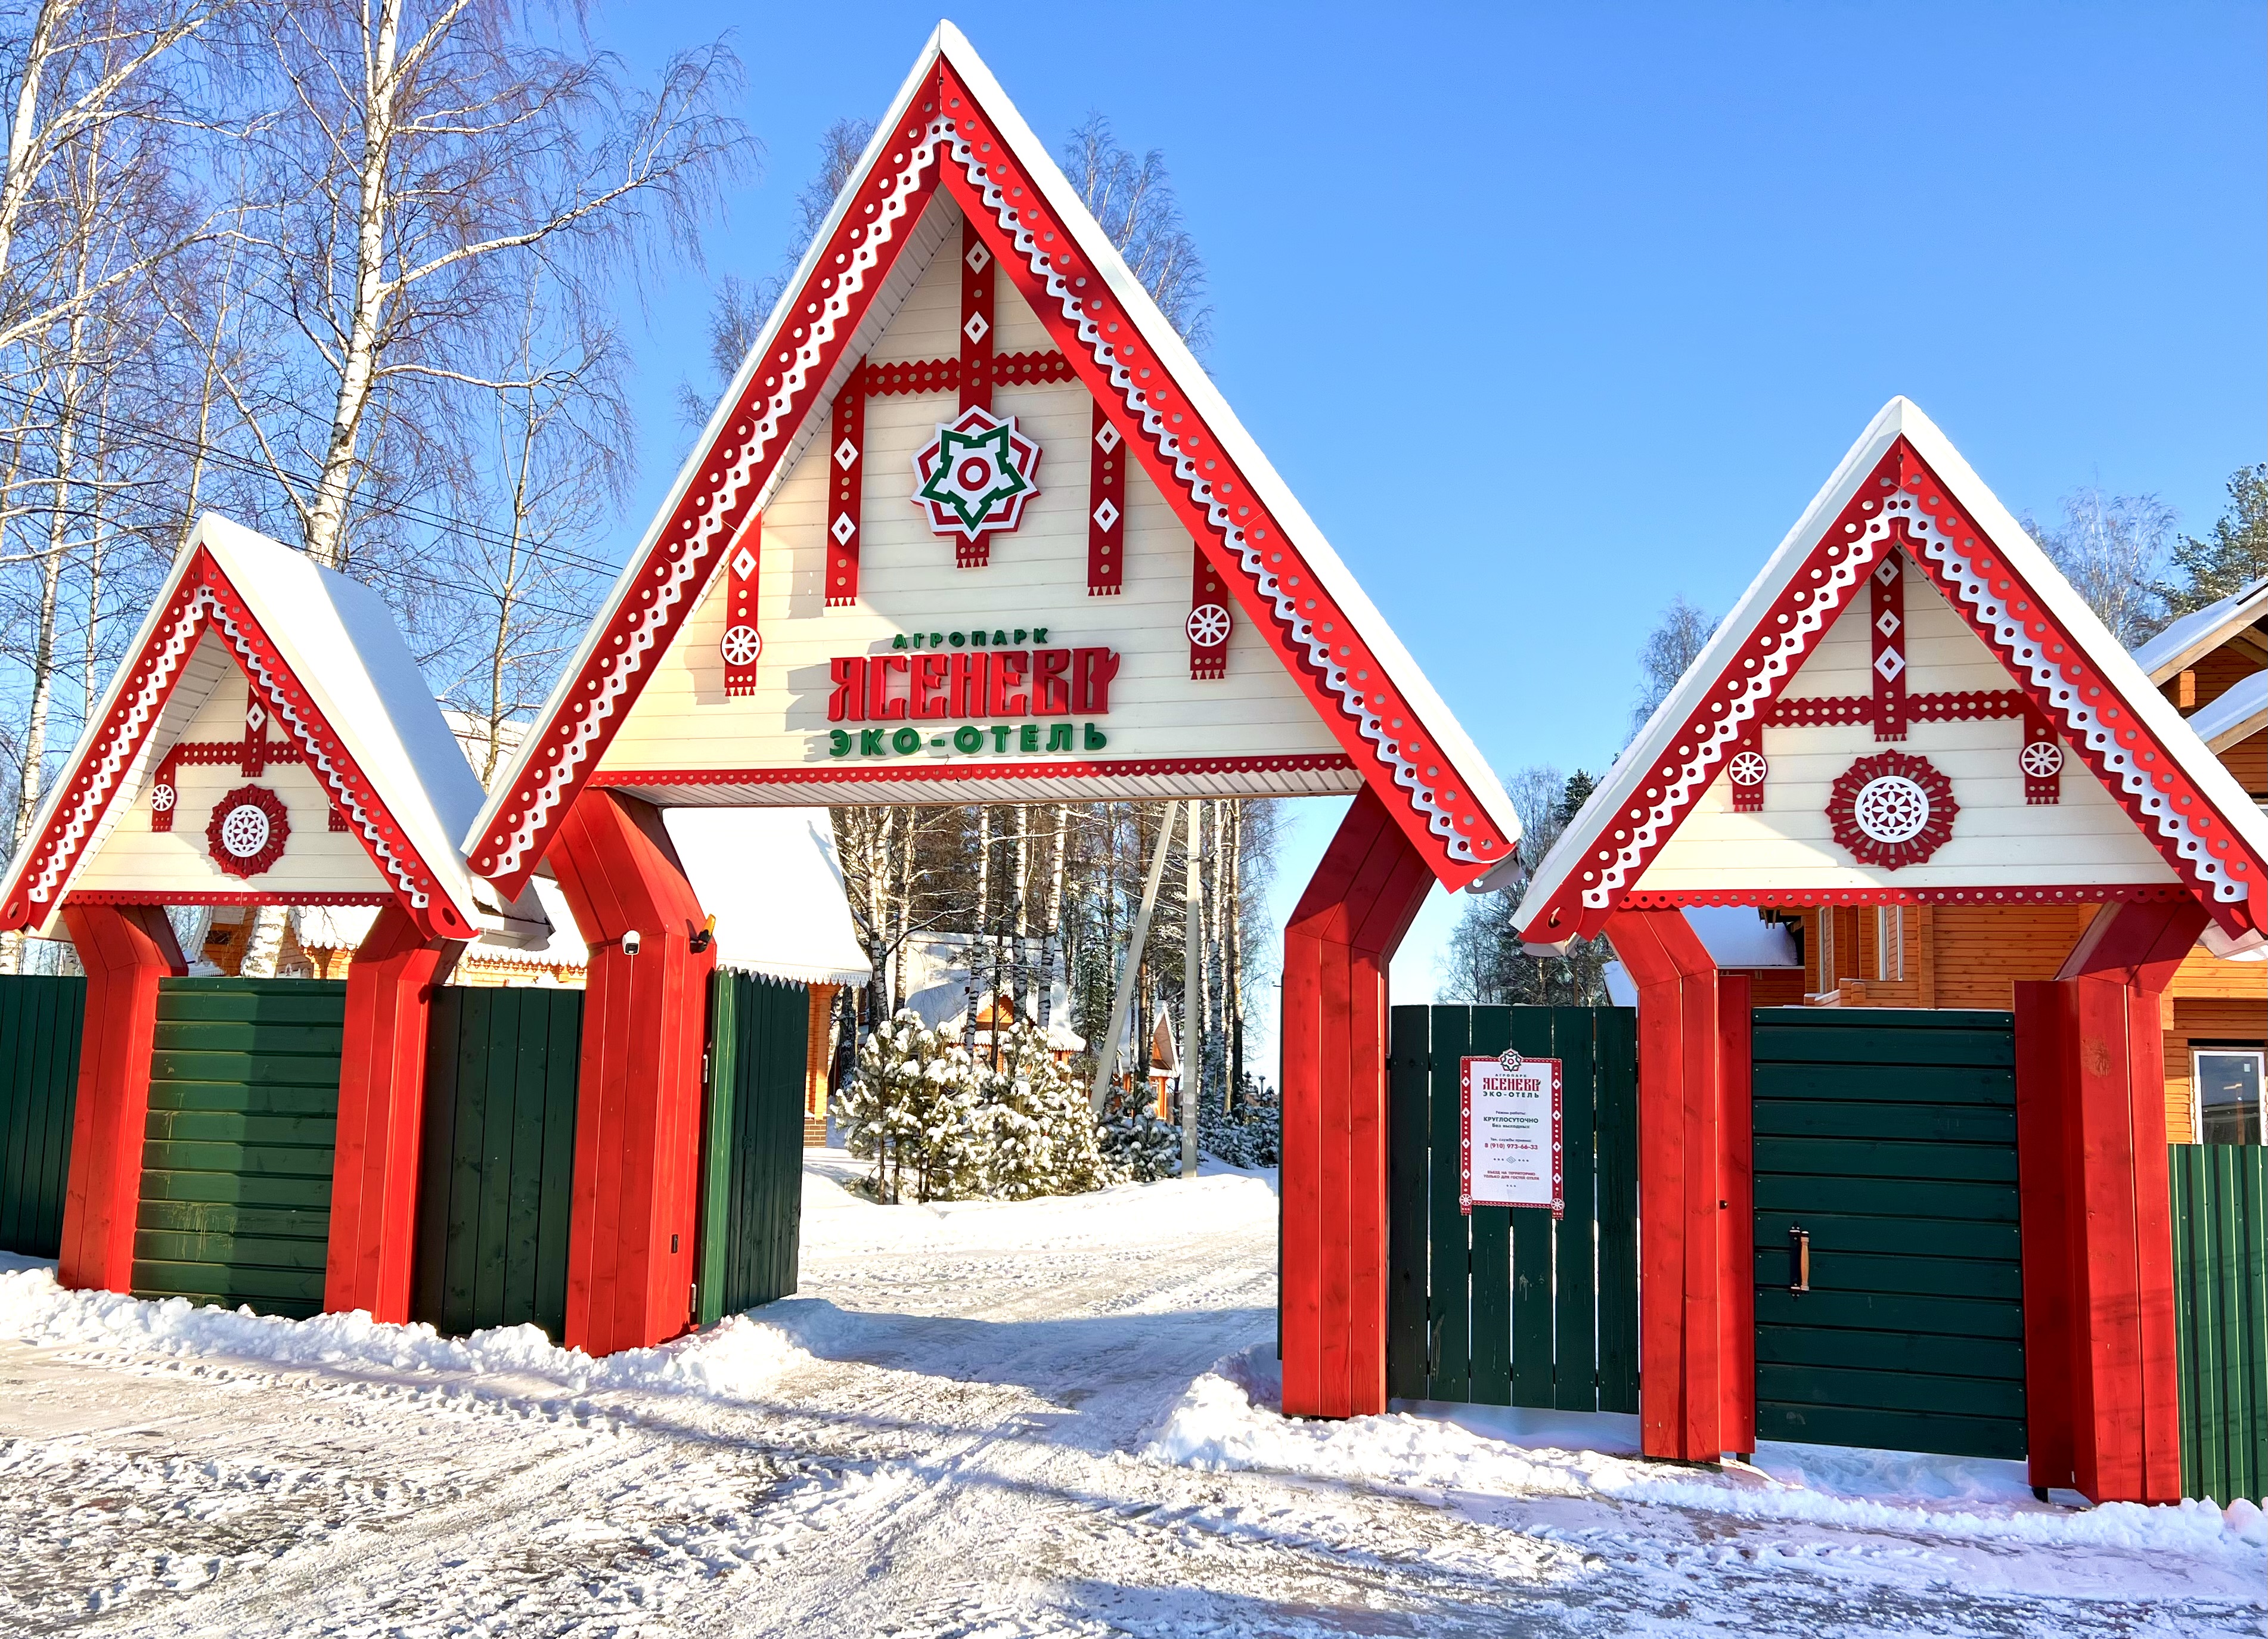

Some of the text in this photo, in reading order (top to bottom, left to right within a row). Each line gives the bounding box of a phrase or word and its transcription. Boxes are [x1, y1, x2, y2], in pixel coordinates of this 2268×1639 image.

[892, 628, 1048, 649] АГРОПАРК
[827, 647, 1120, 722] ЯСЕНЕВО
[829, 723, 1107, 757] ЭКО-ОТЕЛЬ
[1483, 1078, 1541, 1091] ЯСЕНЕВО
